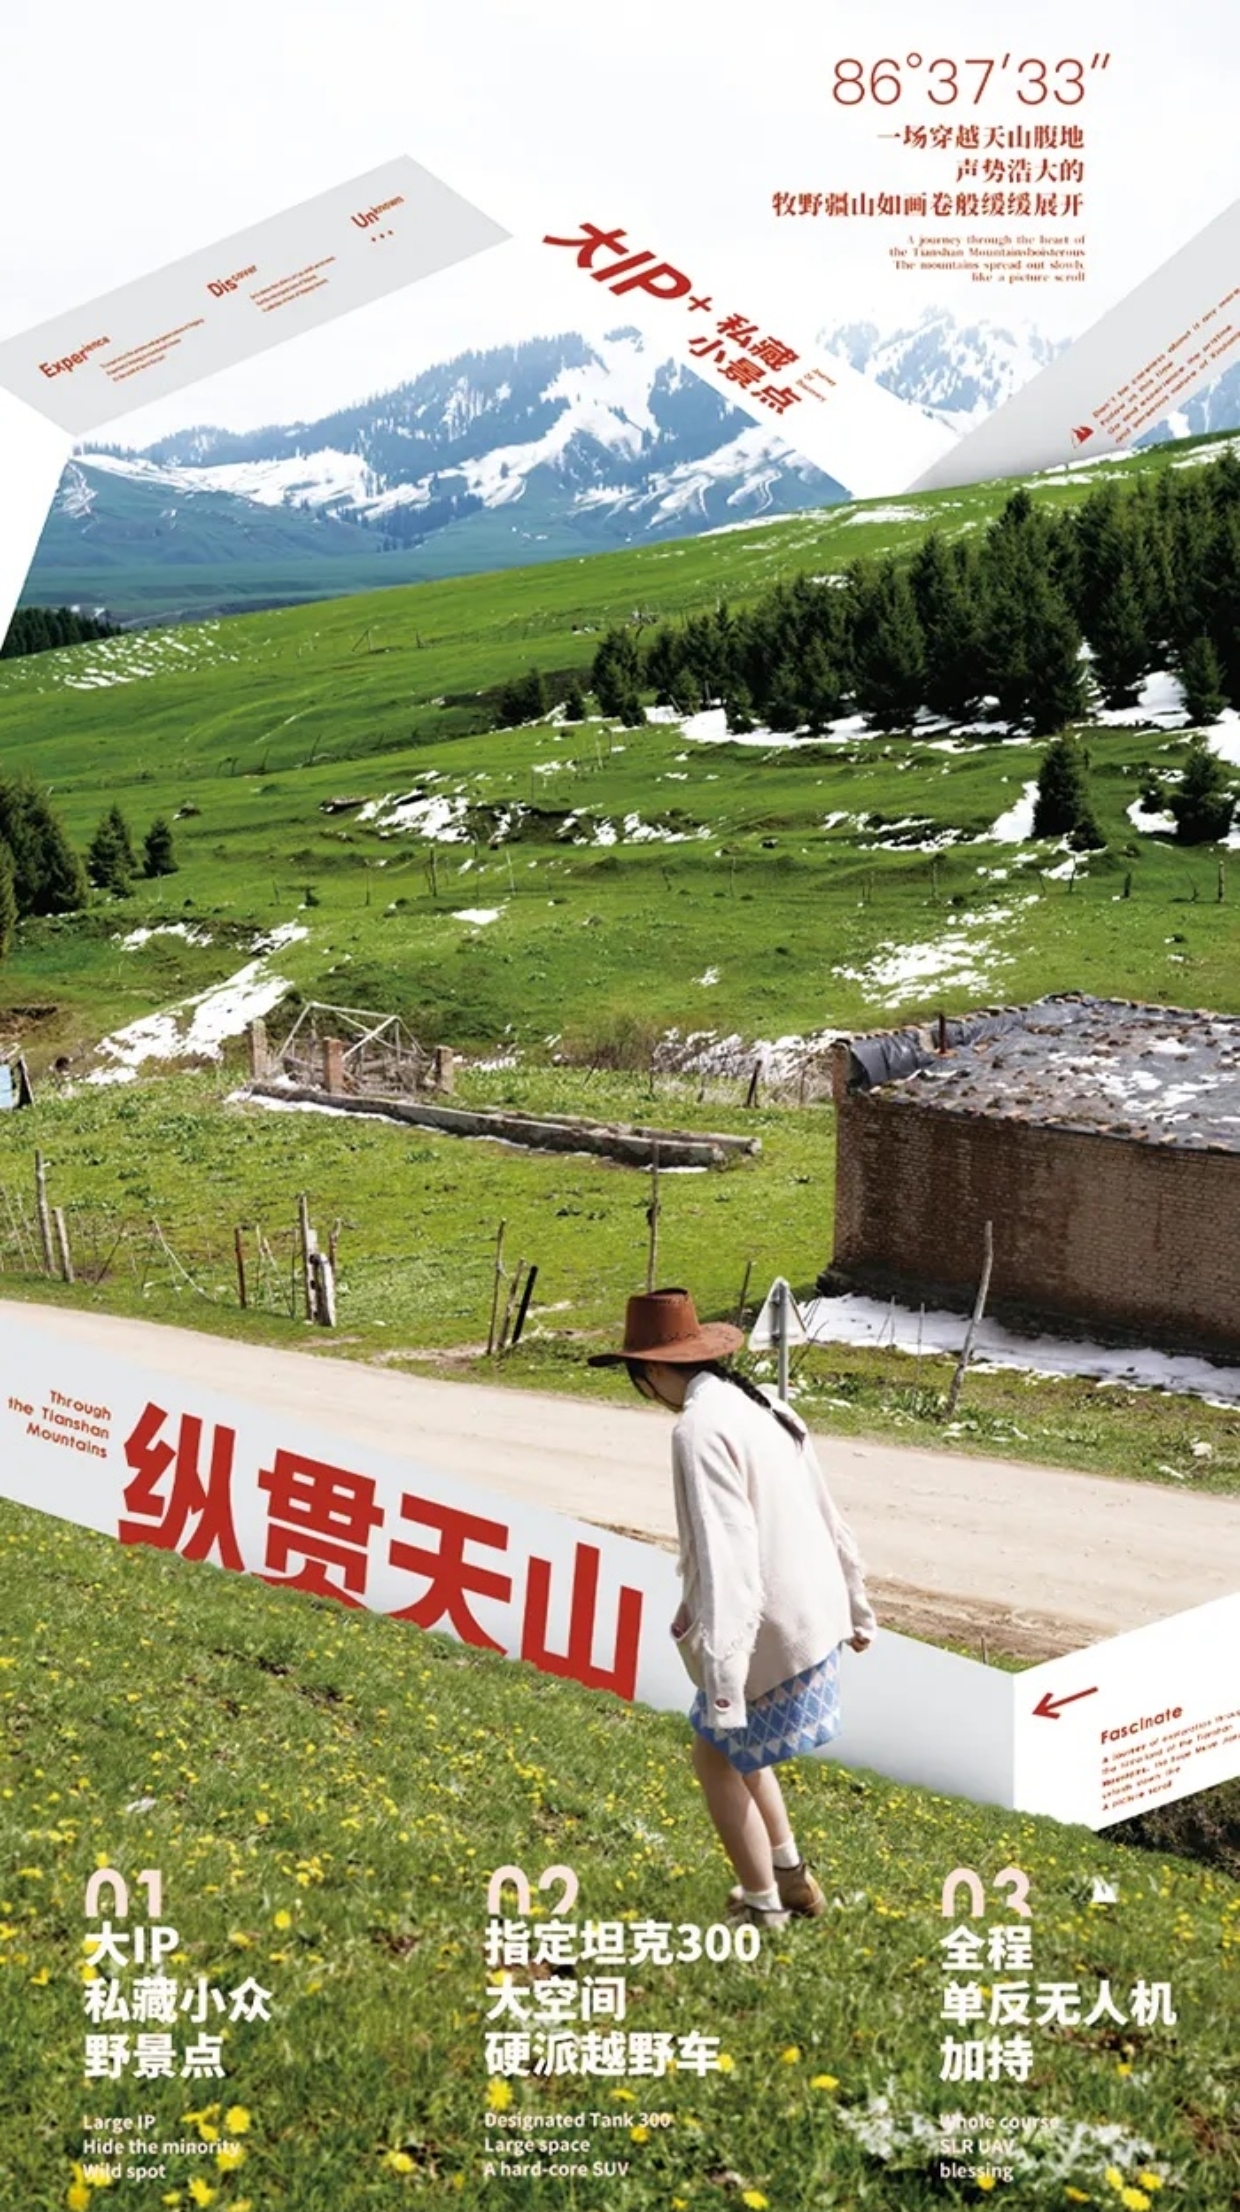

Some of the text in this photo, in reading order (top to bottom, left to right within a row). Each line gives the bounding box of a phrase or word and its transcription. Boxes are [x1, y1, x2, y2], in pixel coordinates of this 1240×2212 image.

[716, 313, 800, 372] 私藏
[688, 336, 802, 415] 小景点
[7, 1396, 110, 1439] the Tianshan
[50, 1389, 112, 1421] Through
[26, 1421, 108, 1459] Mountains
[117, 1402, 643, 1702] 纵贯天山
[1100, 1706, 1182, 1745] Fascinate
